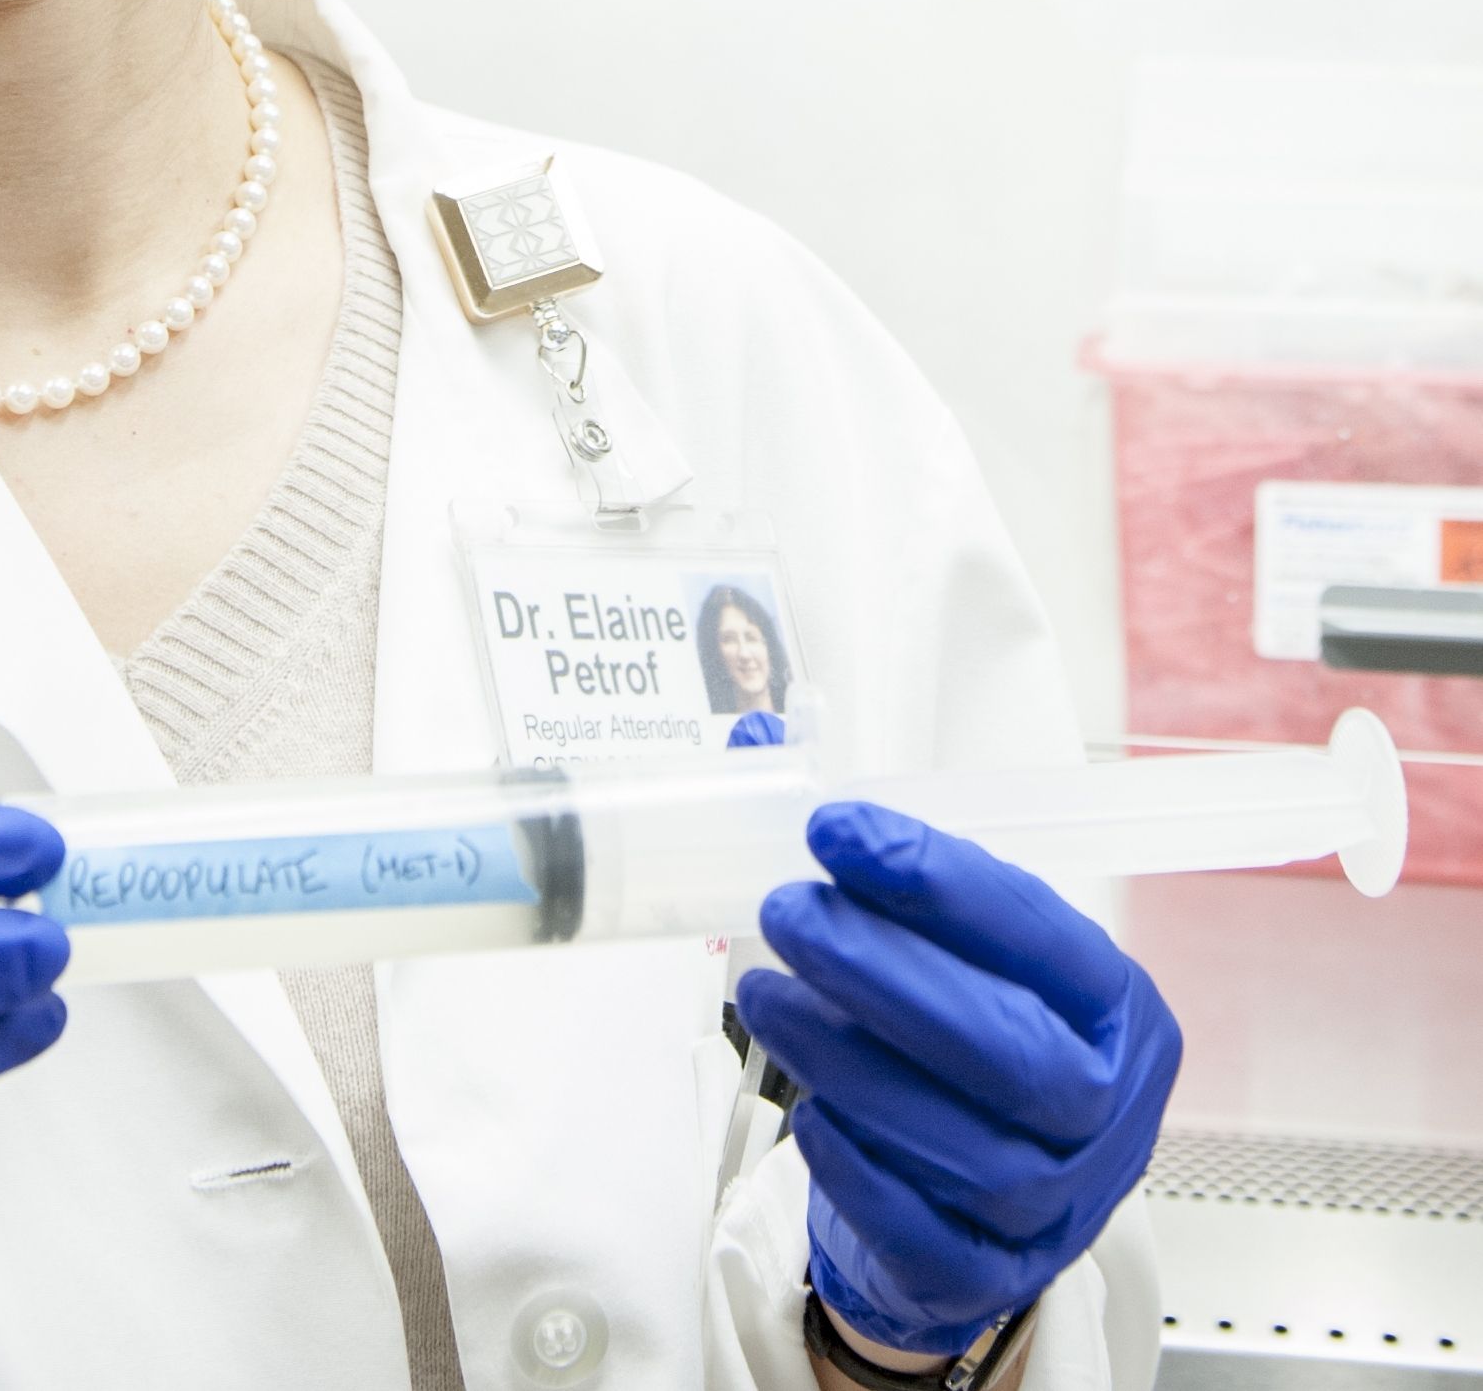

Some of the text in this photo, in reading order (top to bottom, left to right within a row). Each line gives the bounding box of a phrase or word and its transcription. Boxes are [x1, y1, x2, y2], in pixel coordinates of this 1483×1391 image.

[492, 590, 688, 641] Dr. Elaine
[545, 649, 661, 696] Petrof
[523, 713, 702, 748] Regular Attending
[67, 848, 329, 910] REPOOPULATE
